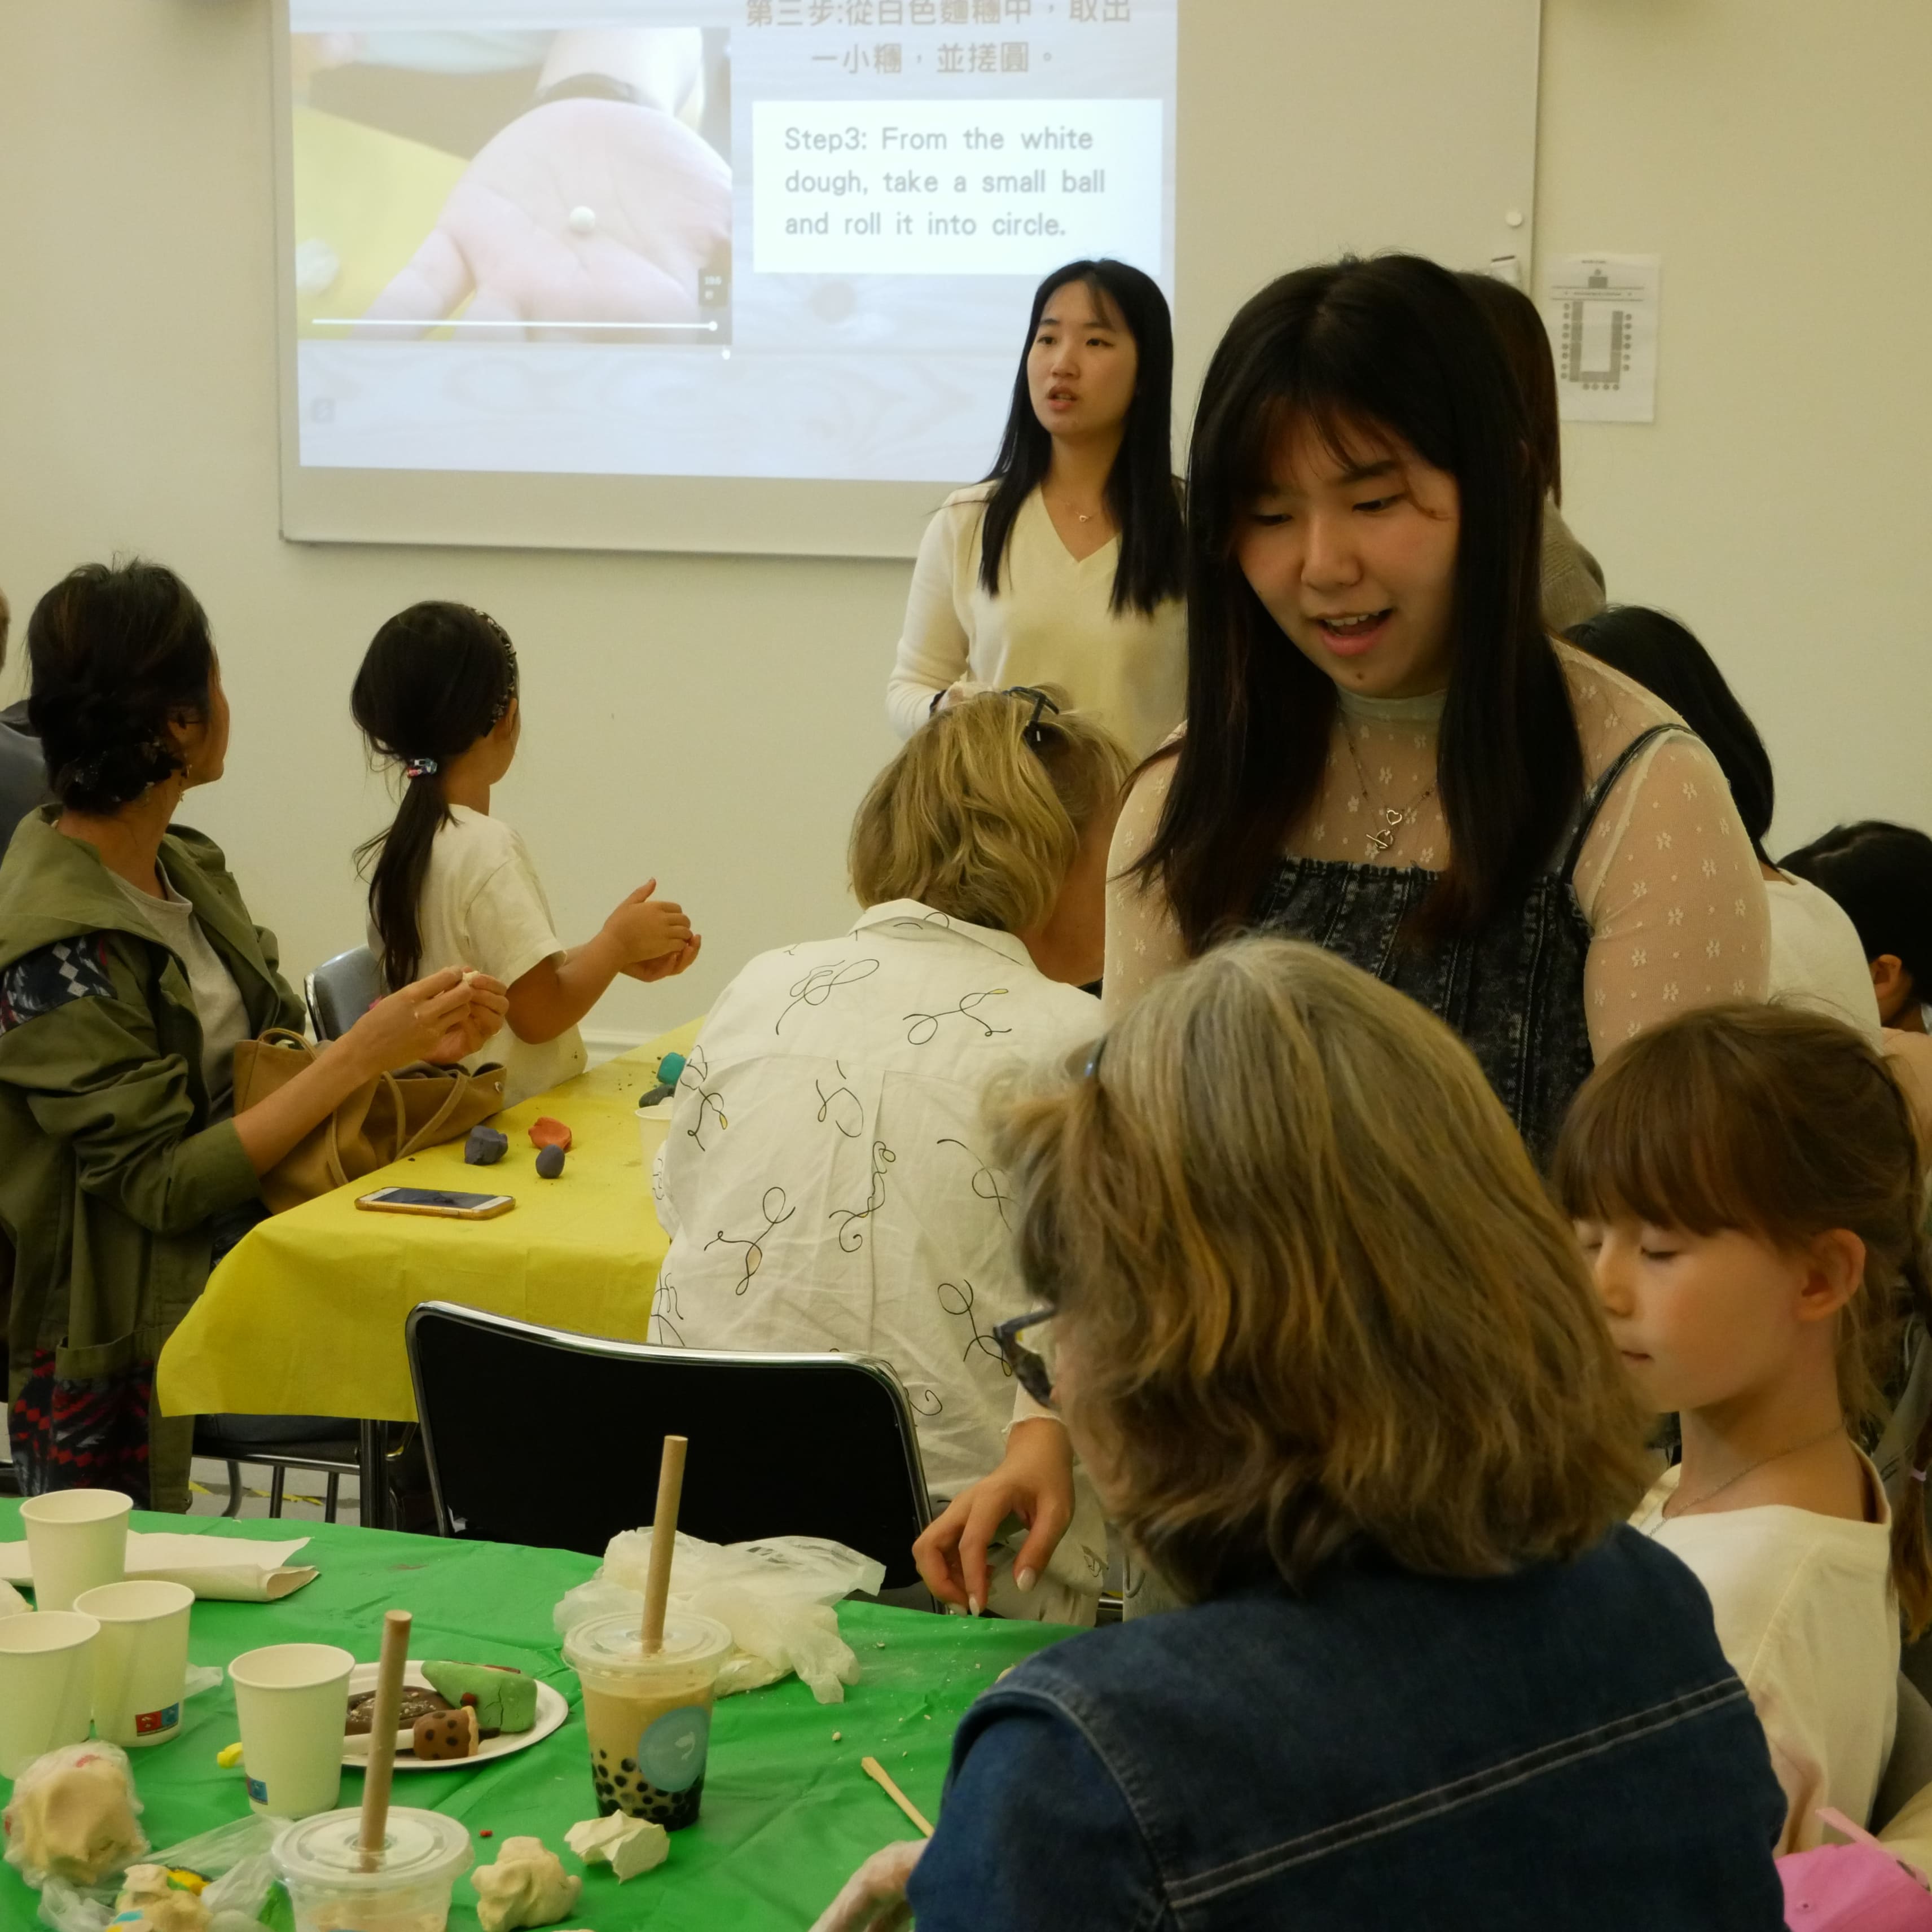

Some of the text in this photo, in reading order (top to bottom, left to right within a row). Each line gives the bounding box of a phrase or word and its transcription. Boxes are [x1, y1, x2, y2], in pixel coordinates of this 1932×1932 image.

[785, 125, 1094, 153] Step3: From the white
[785, 169, 1105, 196] dough, take a small ball
[785, 211, 1066, 236] and roll it into circle.
